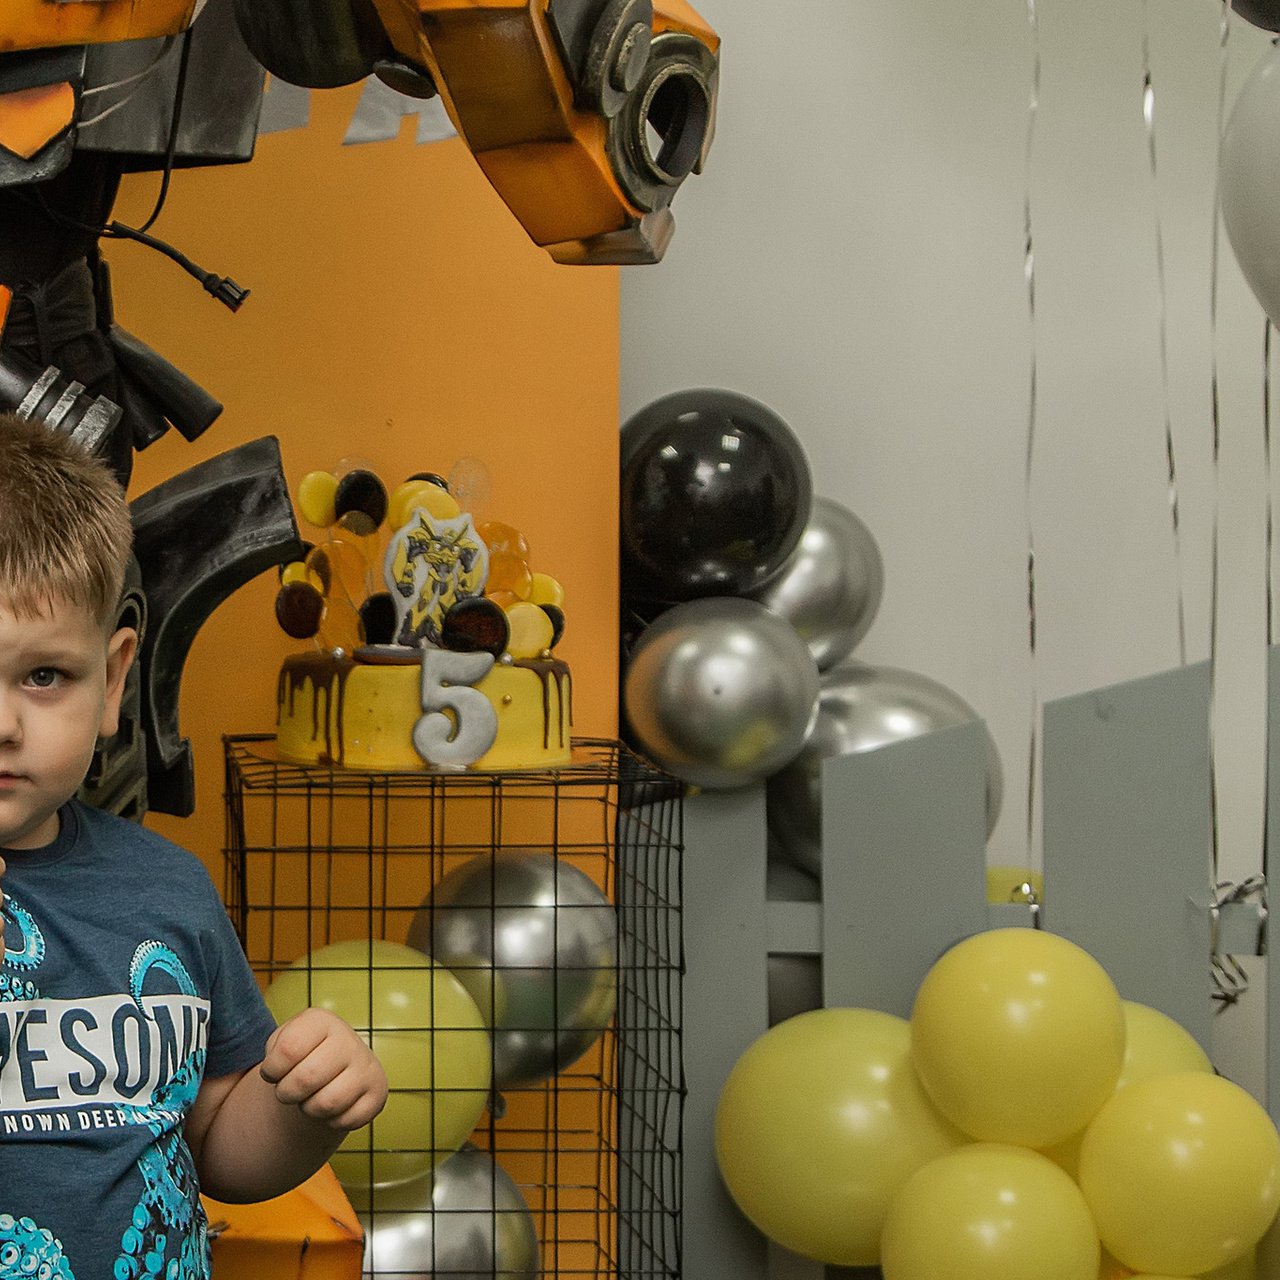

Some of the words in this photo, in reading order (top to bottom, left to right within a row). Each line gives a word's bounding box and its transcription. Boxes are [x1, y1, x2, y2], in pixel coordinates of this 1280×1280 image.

[412, 643, 499, 770] 5
[78, 1106, 127, 1130] DEEP
[130, 1109, 186, 1126] MONS
